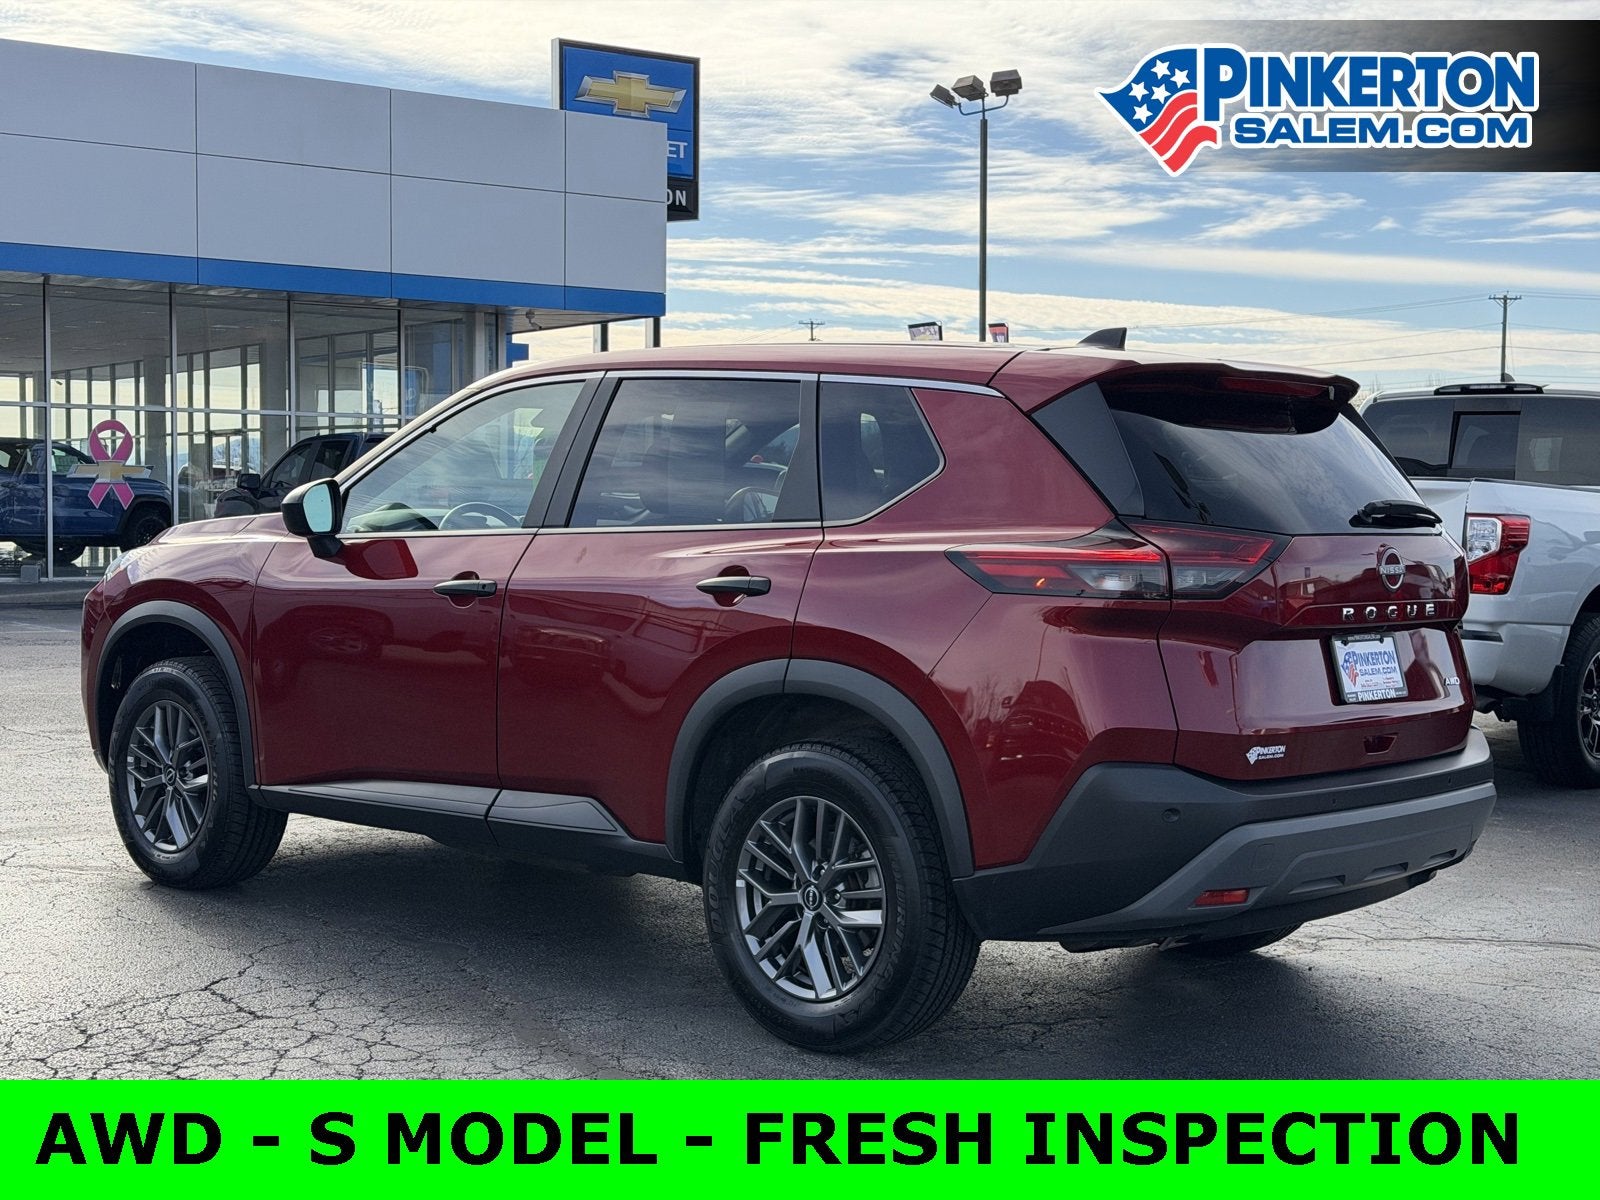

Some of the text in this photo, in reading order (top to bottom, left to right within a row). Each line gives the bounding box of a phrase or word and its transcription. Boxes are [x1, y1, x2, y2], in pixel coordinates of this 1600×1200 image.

[1343, 603, 1435, 621] ROGUE
[1352, 650, 1396, 671] PINKERTON
[1359, 666, 1398, 677] SALEM.COM
[1445, 676, 1461, 686] AWD
[1358, 688, 1396, 701] PINKERTON
[1256, 745, 1286, 755] PINKERTON
